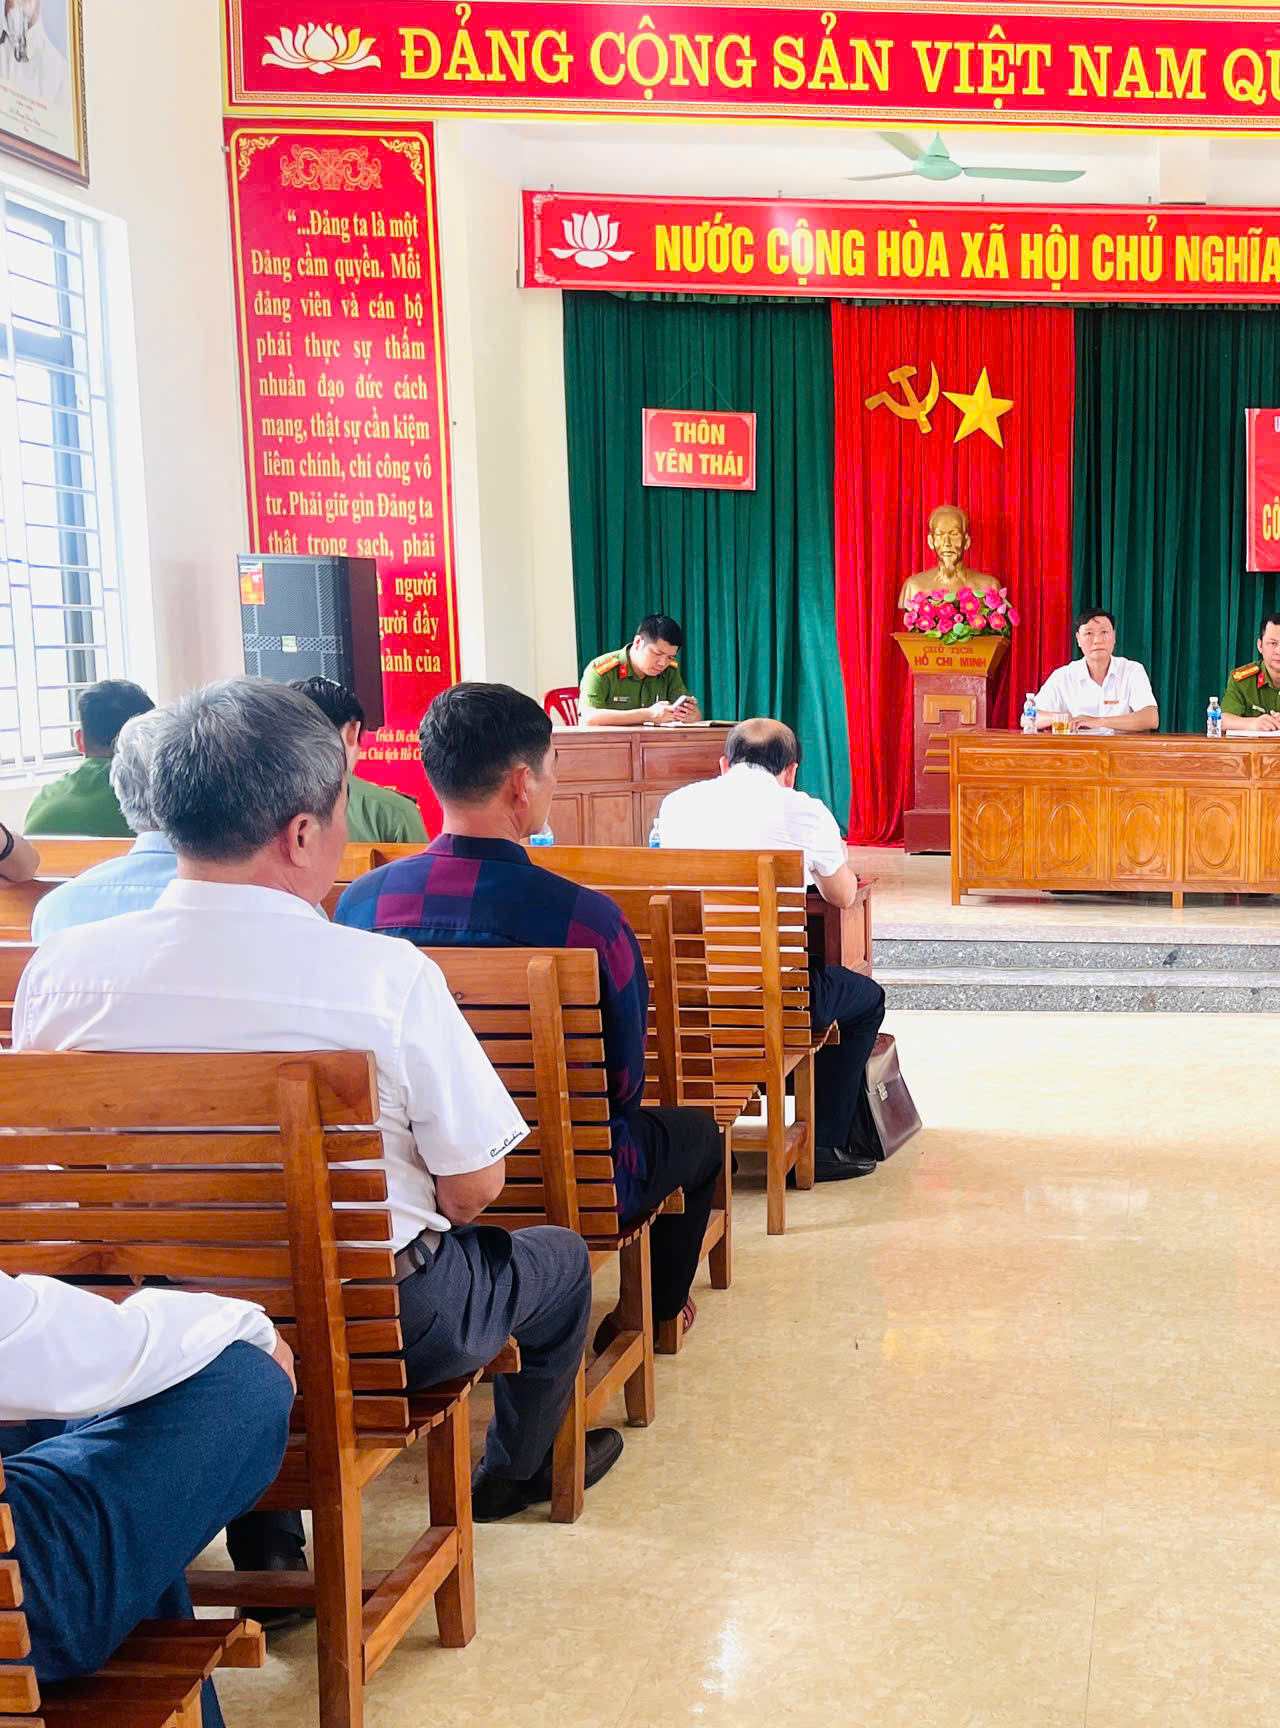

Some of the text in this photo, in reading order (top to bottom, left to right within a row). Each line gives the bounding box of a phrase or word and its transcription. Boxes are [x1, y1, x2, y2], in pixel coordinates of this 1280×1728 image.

[399, 3, 574, 83] ĐẢNG
[590, 15, 757, 100] CỘNG
[773, 11, 893, 91] SẢN
[912, 24, 1052, 109] VIỆT
[1068, 45, 1207, 99] NAM
[353, 212, 368, 236] ta
[371, 211, 385, 237] là
[389, 211, 419, 246] một
[251, 242, 421, 285] Đảng cầm quyền. Mỗi
[655, 212, 755, 272] NƯỚC
[766, 219, 865, 285] CỘNG
[878, 219, 950, 278] HÒA
[961, 224, 1008, 279] XÃ
[1021, 223, 1079, 290] HỘI
[1092, 215, 1163, 282] CHỦ
[254, 290, 424, 327] đảng viên và cán bộ
[256, 327, 425, 366] phải thực sự thấm
[258, 364, 428, 404] nhuần đạo đức cách
[261, 406, 430, 447] mạng, thật sự cần kiệm
[672, 419, 725, 445] THÔN
[263, 450, 432, 486] liêm chính, chí công vô
[654, 448, 743, 476] YÊN THÁI
[266, 491, 433, 525] tư. Phải giữ gìn Đảng ta
[395, 571, 438, 603] người
[379, 603, 439, 641] gười đầy
[416, 648, 441, 672] của
[960, 657, 987, 667] MINH
